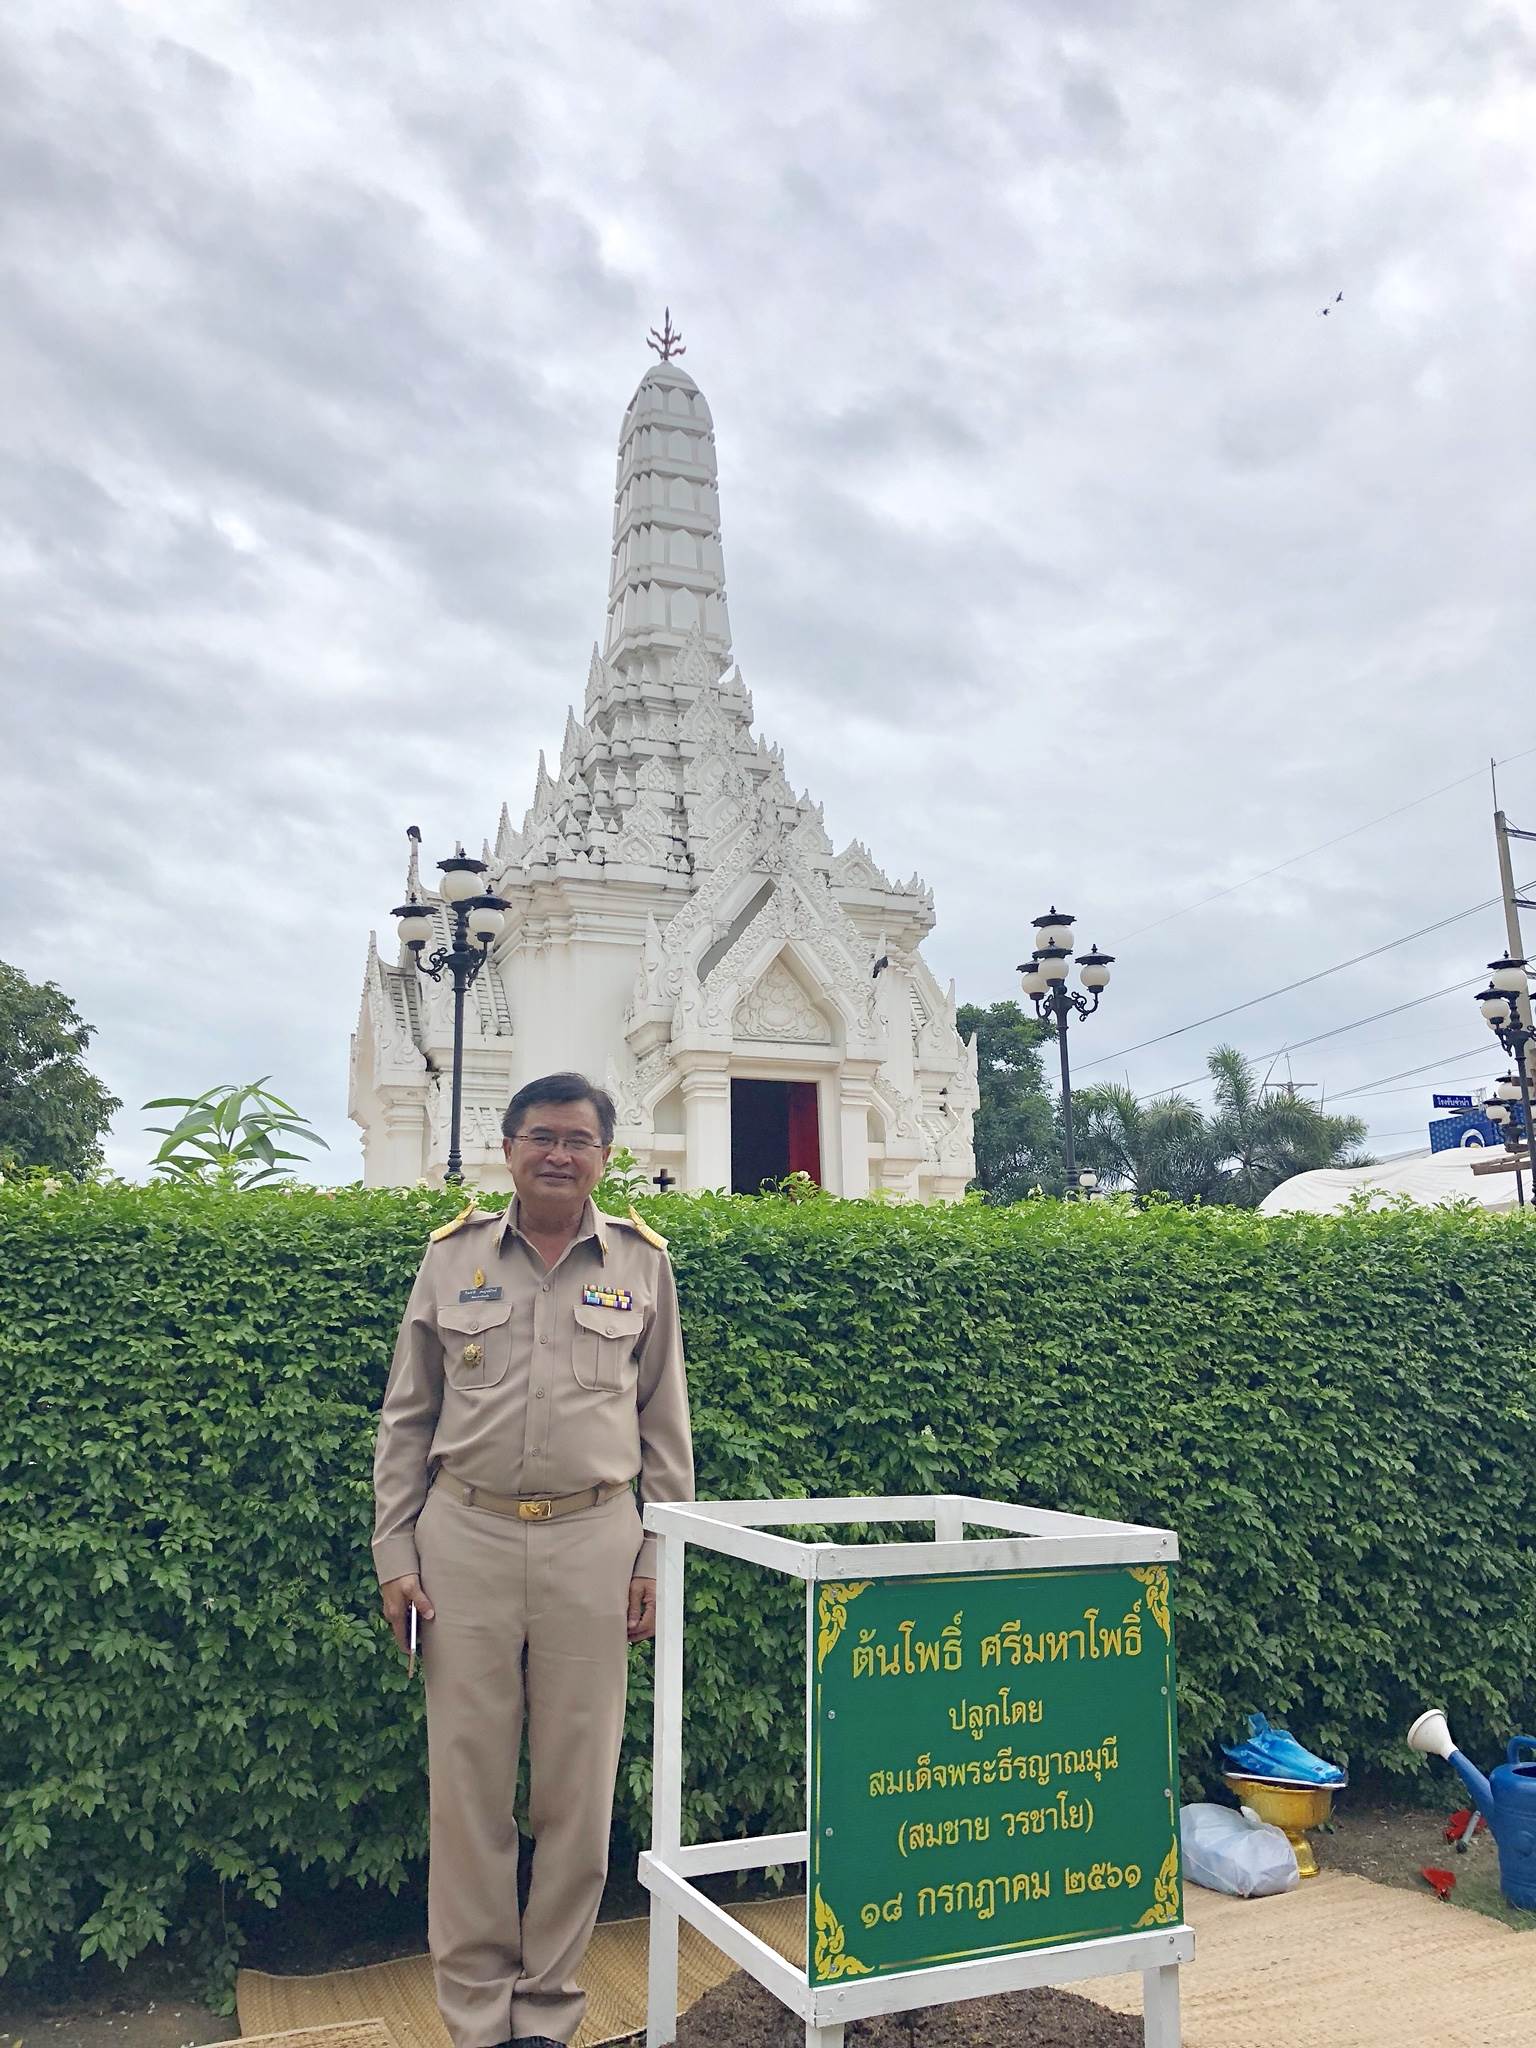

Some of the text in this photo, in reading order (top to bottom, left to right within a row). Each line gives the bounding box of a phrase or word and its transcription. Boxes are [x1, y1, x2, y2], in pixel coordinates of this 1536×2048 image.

[852, 1599, 1142, 1678] ต้นโพธิ์ ศรีมหาโพธิ์
[948, 1686, 1043, 1741] ปลูกโดย
[869, 1735, 1118, 1797] สมเด็จพระธีรญาณมุนี
[898, 1790, 1094, 1857] (สมชาย วรชาโย)
[860, 1861, 1142, 1929] ๑๘ กรกฎาคม ๒๕๖๑
